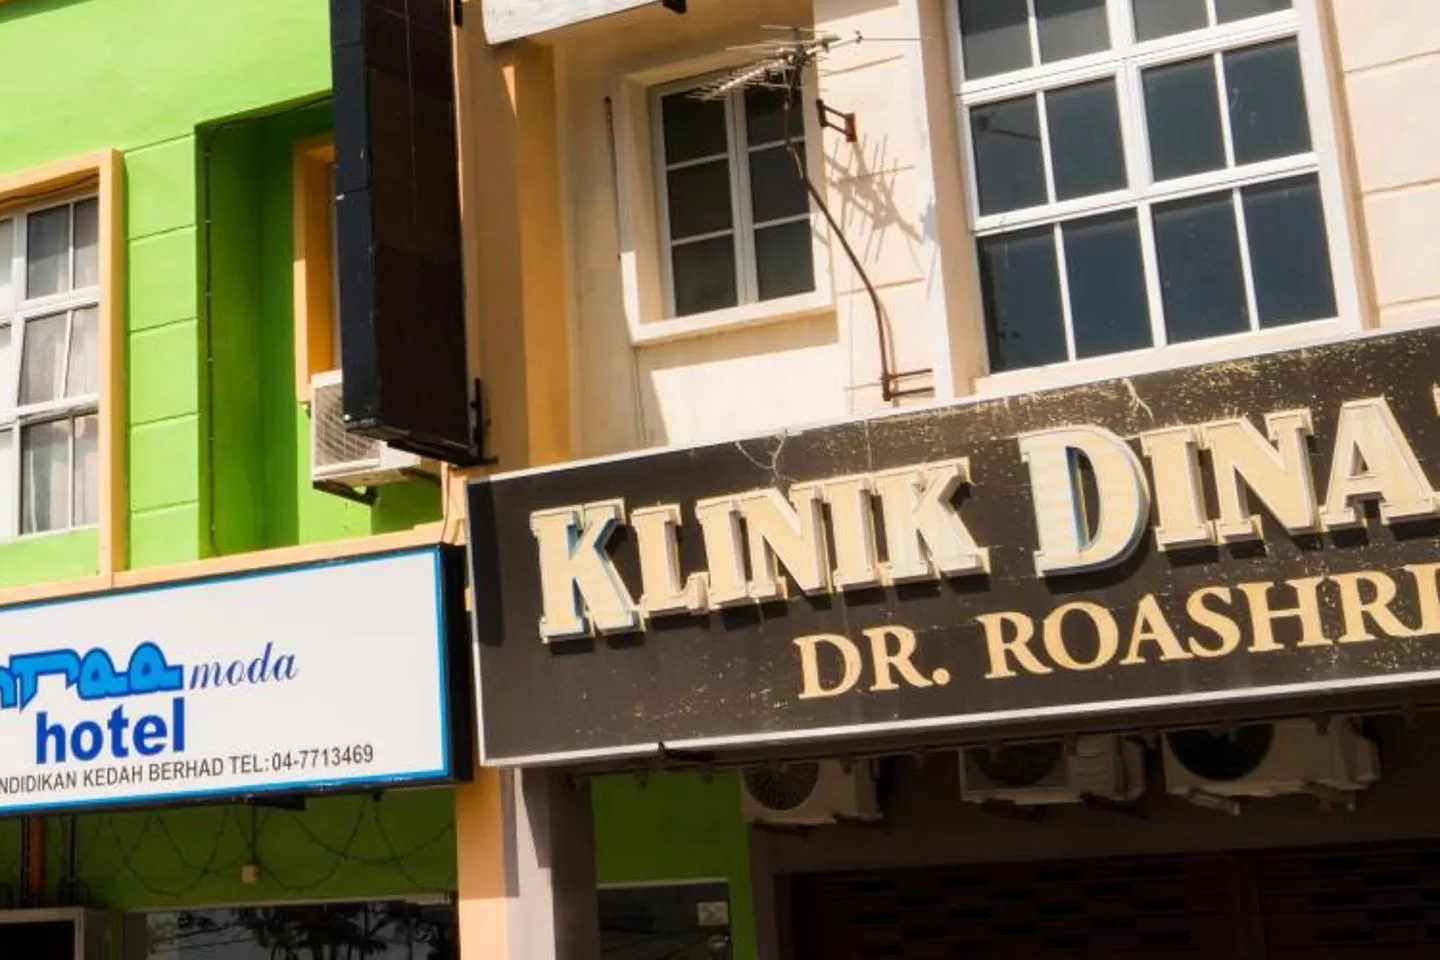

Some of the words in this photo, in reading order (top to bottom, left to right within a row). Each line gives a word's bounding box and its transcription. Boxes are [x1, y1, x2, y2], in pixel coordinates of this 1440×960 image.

[530, 456, 990, 643] KLINIK
[1018, 382, 1440, 578] DINA
[188, 641, 297, 690] moda
[793, 625, 951, 700] DR.
[35, 697, 185, 764] hotel
[83, 766, 143, 787] KEDAH
[149, 757, 224, 782] BERHAD
